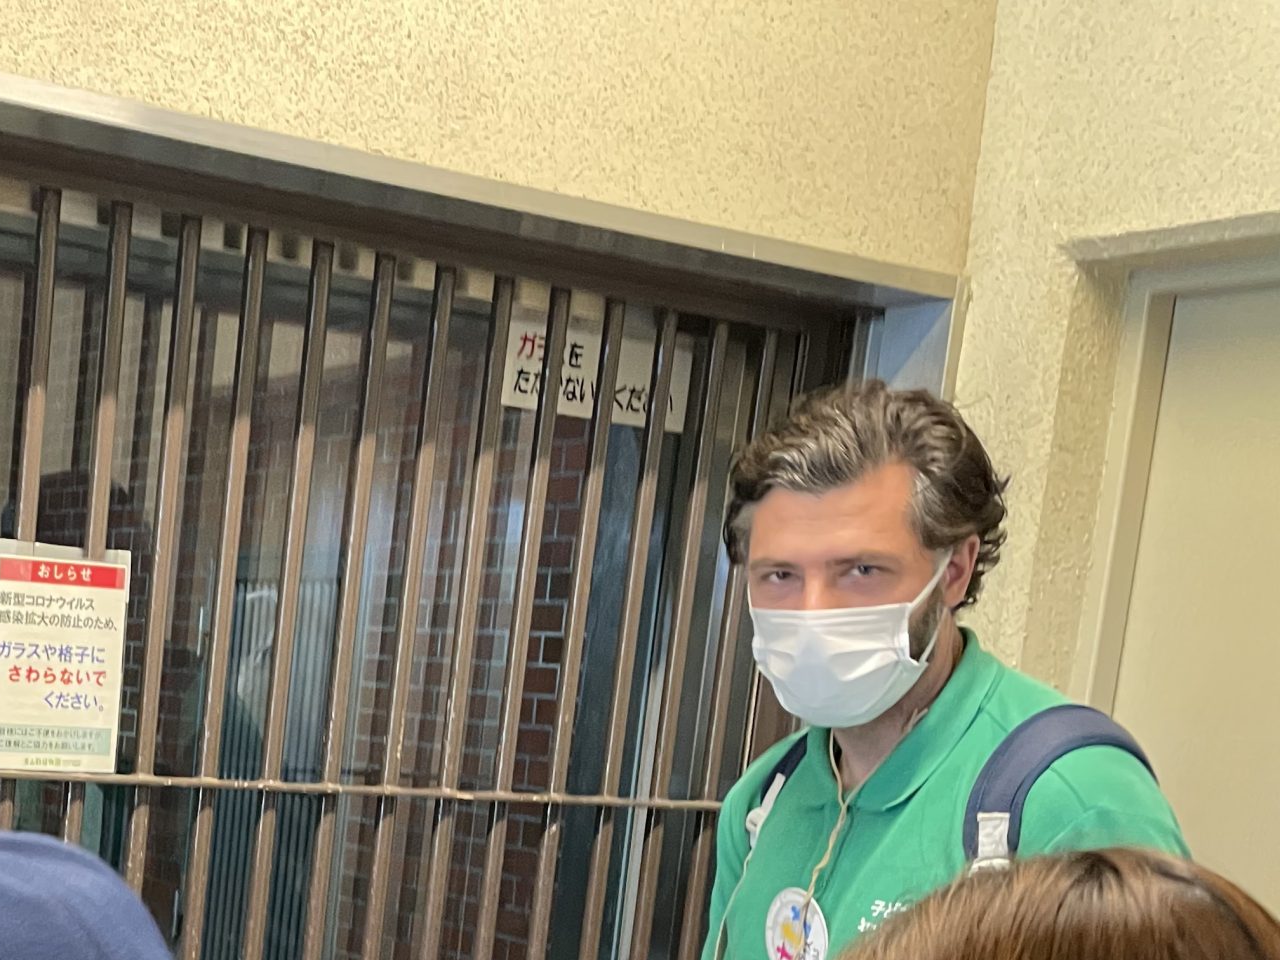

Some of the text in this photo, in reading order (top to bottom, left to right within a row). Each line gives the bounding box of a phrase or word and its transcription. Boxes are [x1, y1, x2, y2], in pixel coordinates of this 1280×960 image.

[37, 563, 93, 582] おしらせ
[0, 590, 95, 611] 新型コロナウイルス
[8, 665, 107, 687] さわらないで
[44, 690, 104, 712] ください。
